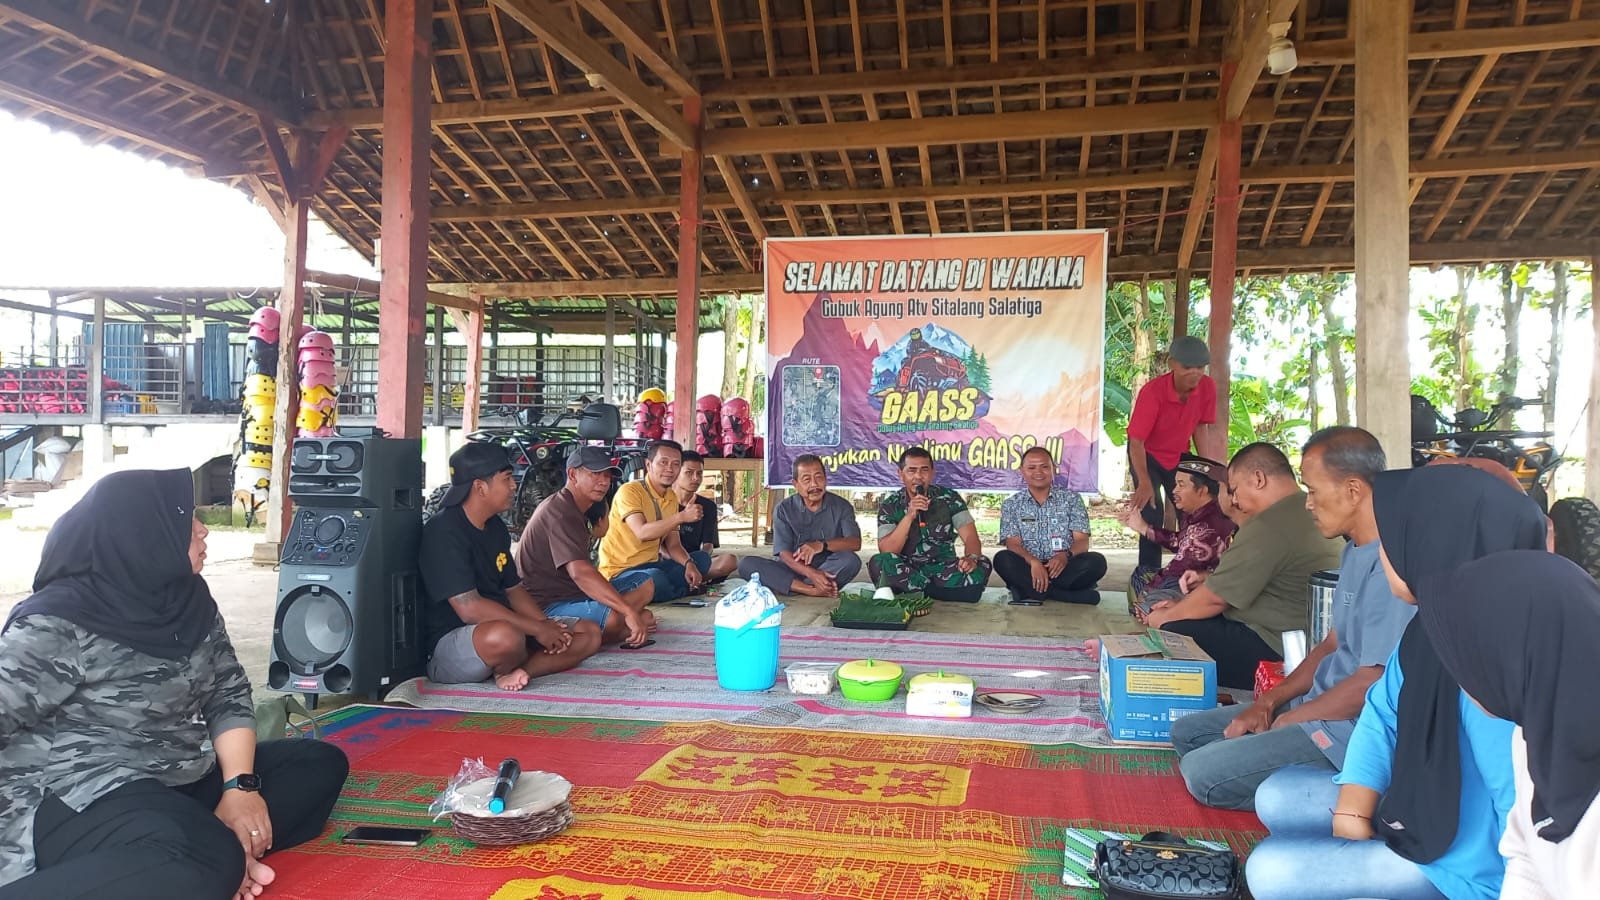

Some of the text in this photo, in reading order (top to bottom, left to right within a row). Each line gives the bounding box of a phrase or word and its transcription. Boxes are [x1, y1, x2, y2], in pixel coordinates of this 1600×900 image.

[783, 255, 1085, 293] SELAMAT DATANG DI WAHANA
[822, 296, 1042, 319] Gubuk Agung Atv Sitalang Salatiga
[881, 387, 978, 425] GAASS
